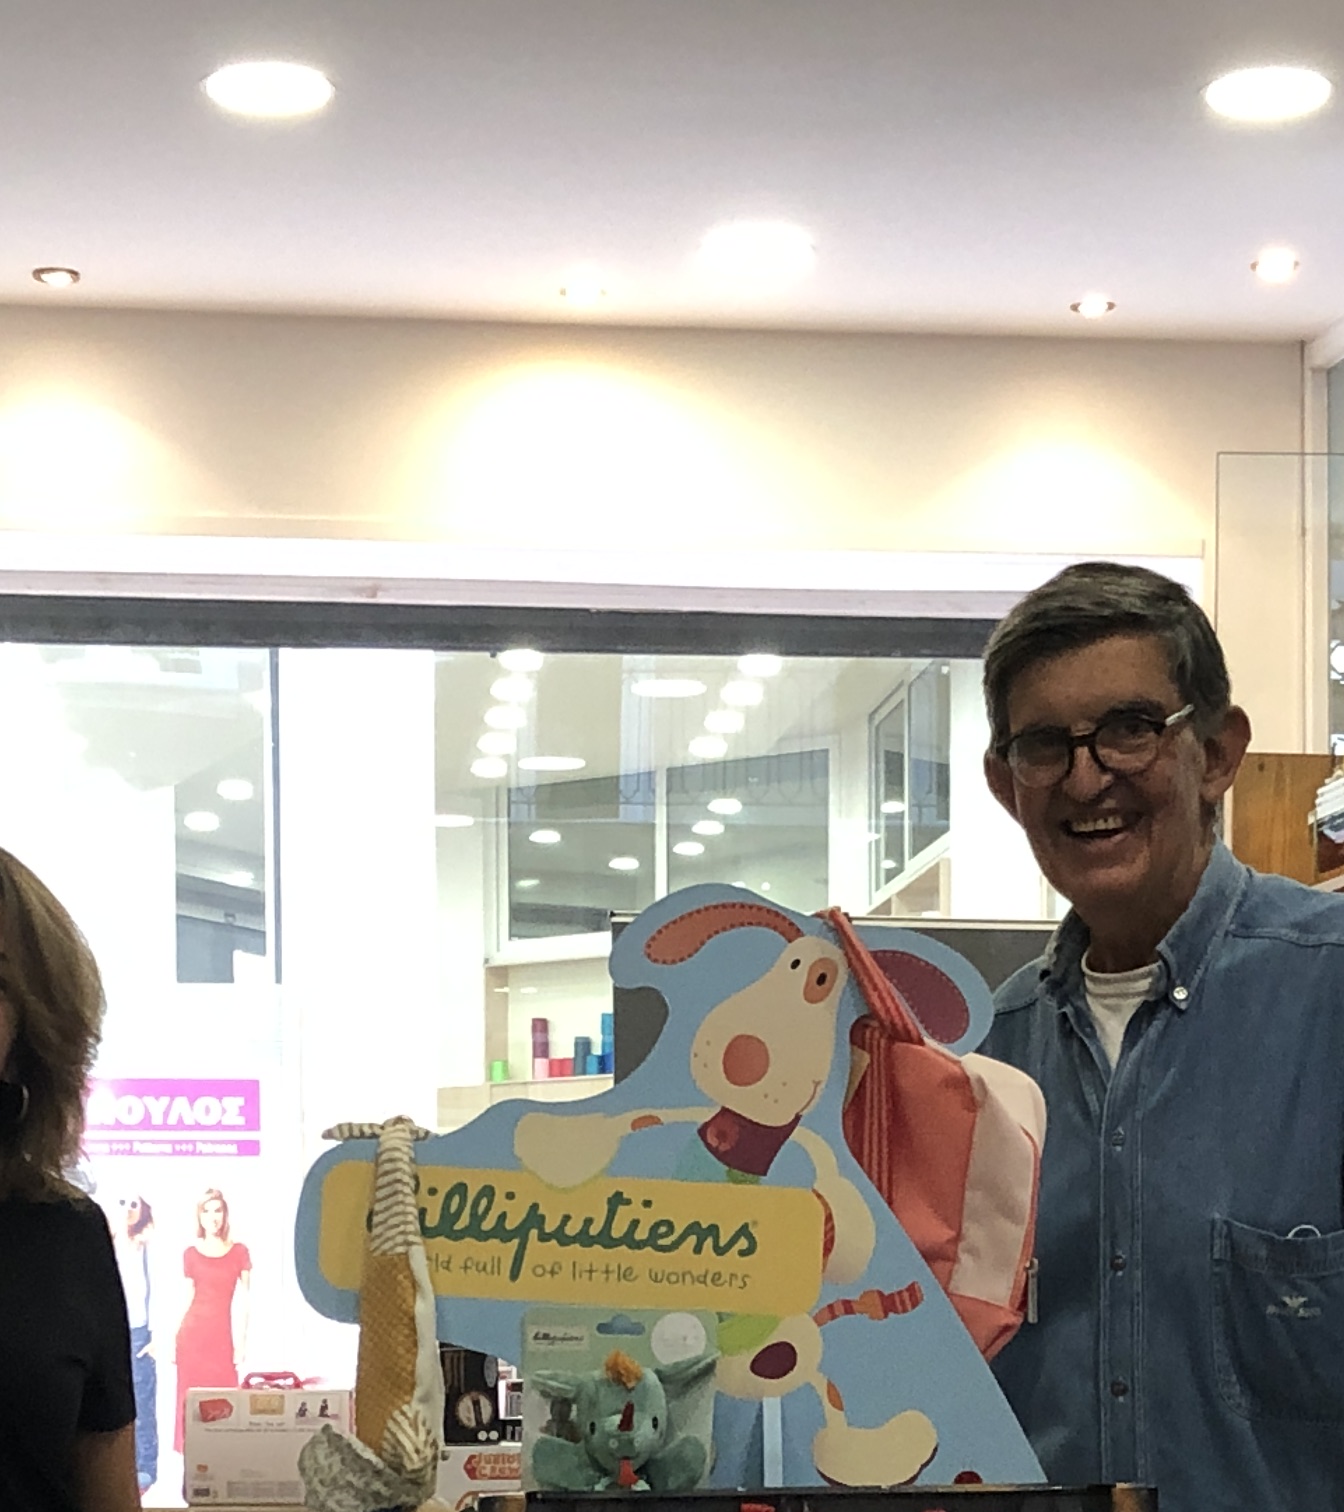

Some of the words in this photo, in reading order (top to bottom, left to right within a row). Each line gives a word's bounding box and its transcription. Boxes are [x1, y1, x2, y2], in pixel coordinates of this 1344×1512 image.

[367, 1173, 757, 1282] illiputiens
[460, 1255, 502, 1276] full
[531, 1262, 562, 1279] of
[572, 1262, 638, 1283] little
[649, 1267, 751, 1290] wonders
